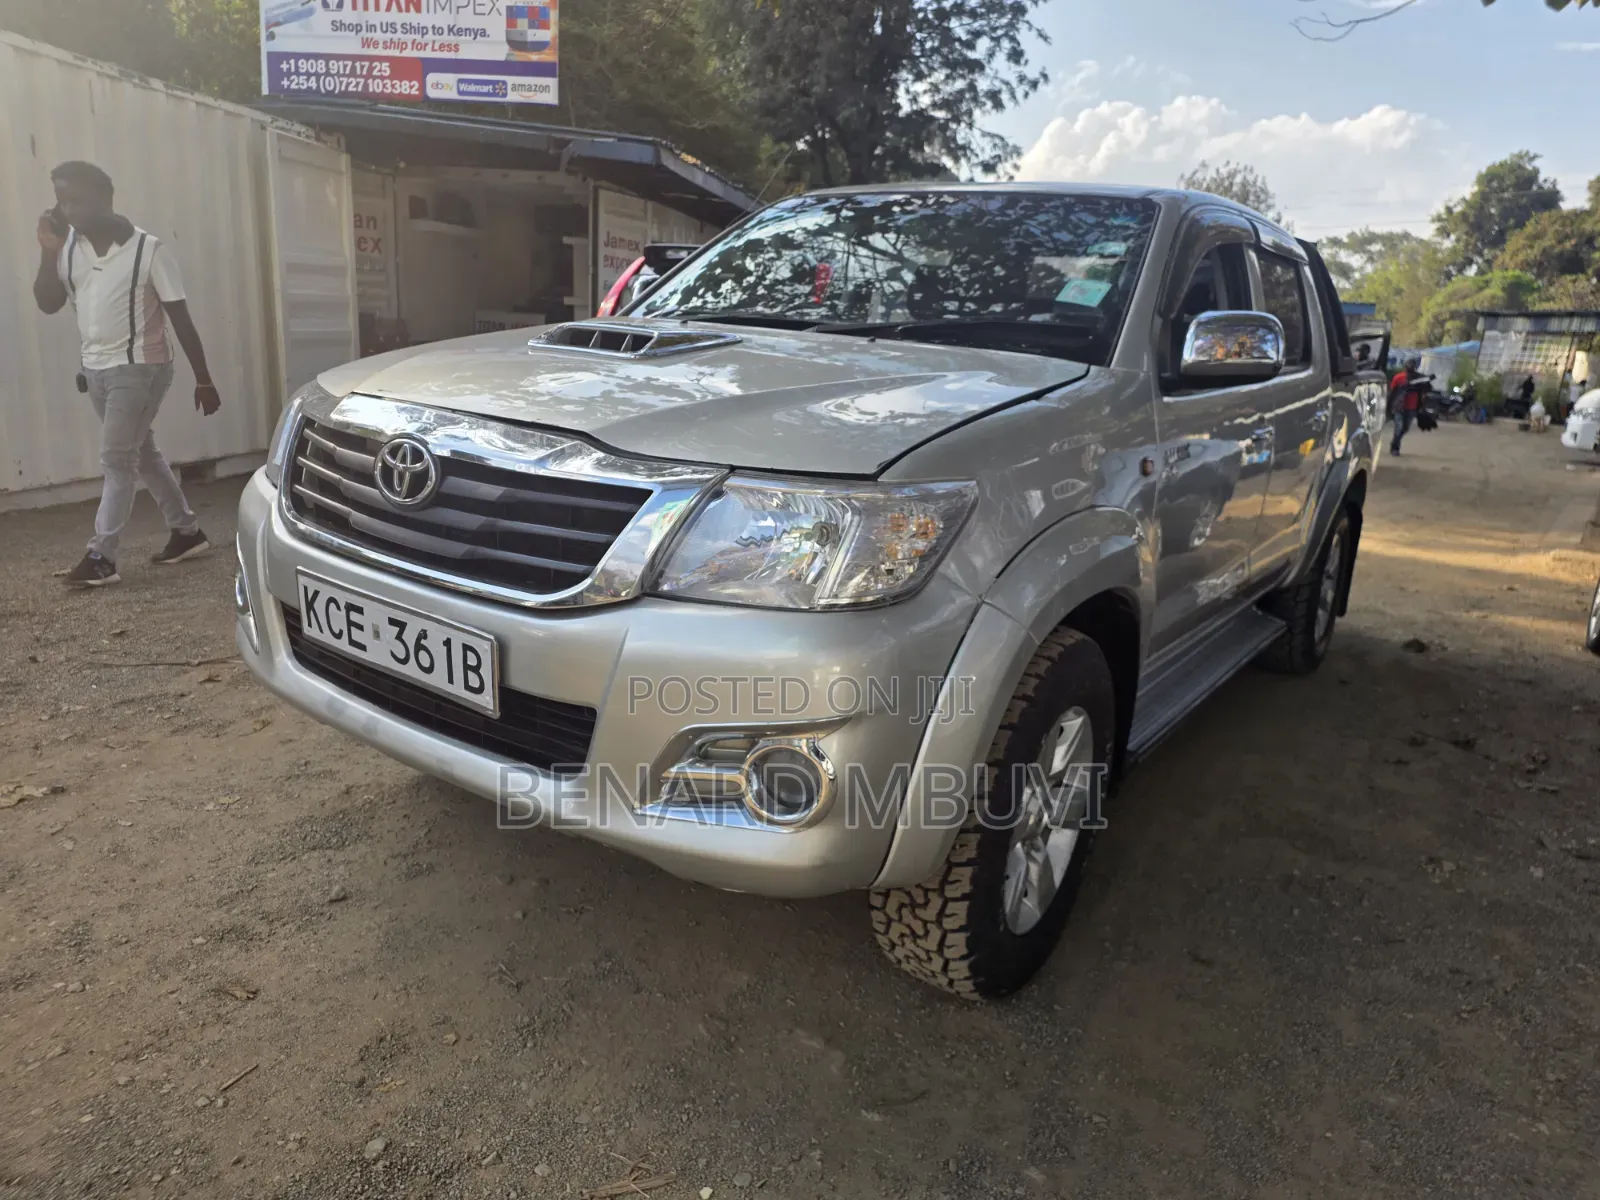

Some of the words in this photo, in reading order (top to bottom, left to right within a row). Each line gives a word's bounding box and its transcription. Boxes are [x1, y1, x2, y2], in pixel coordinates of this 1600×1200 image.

[330, 20, 363, 36] Shop
[365, 21, 377, 33] in
[380, 21, 398, 34] US
[401, 23, 429, 38] Ship
[432, 24, 444, 36] to
[447, 24, 490, 40] Kenya.
[361, 37, 380, 49] We
[382, 38, 409, 53] ship
[411, 40, 429, 52] for
[431, 41, 461, 52] Less
[280, 59, 296, 73] +1
[298, 59, 327, 74] 908
[328, 60, 353, 75] 917
[354, 61, 370, 75] 17
[372, 62, 391, 76] 25
[281, 75, 318, 90] +254
[319, 75, 365, 95] (0)727
[367, 78, 420, 95] 103382
[430, 80, 455, 92] ebay
[458, 82, 494, 93] Walmart
[510, 83, 551, 94] amazon
[303, 585, 368, 653] KCE
[387, 616, 486, 695] 361B
